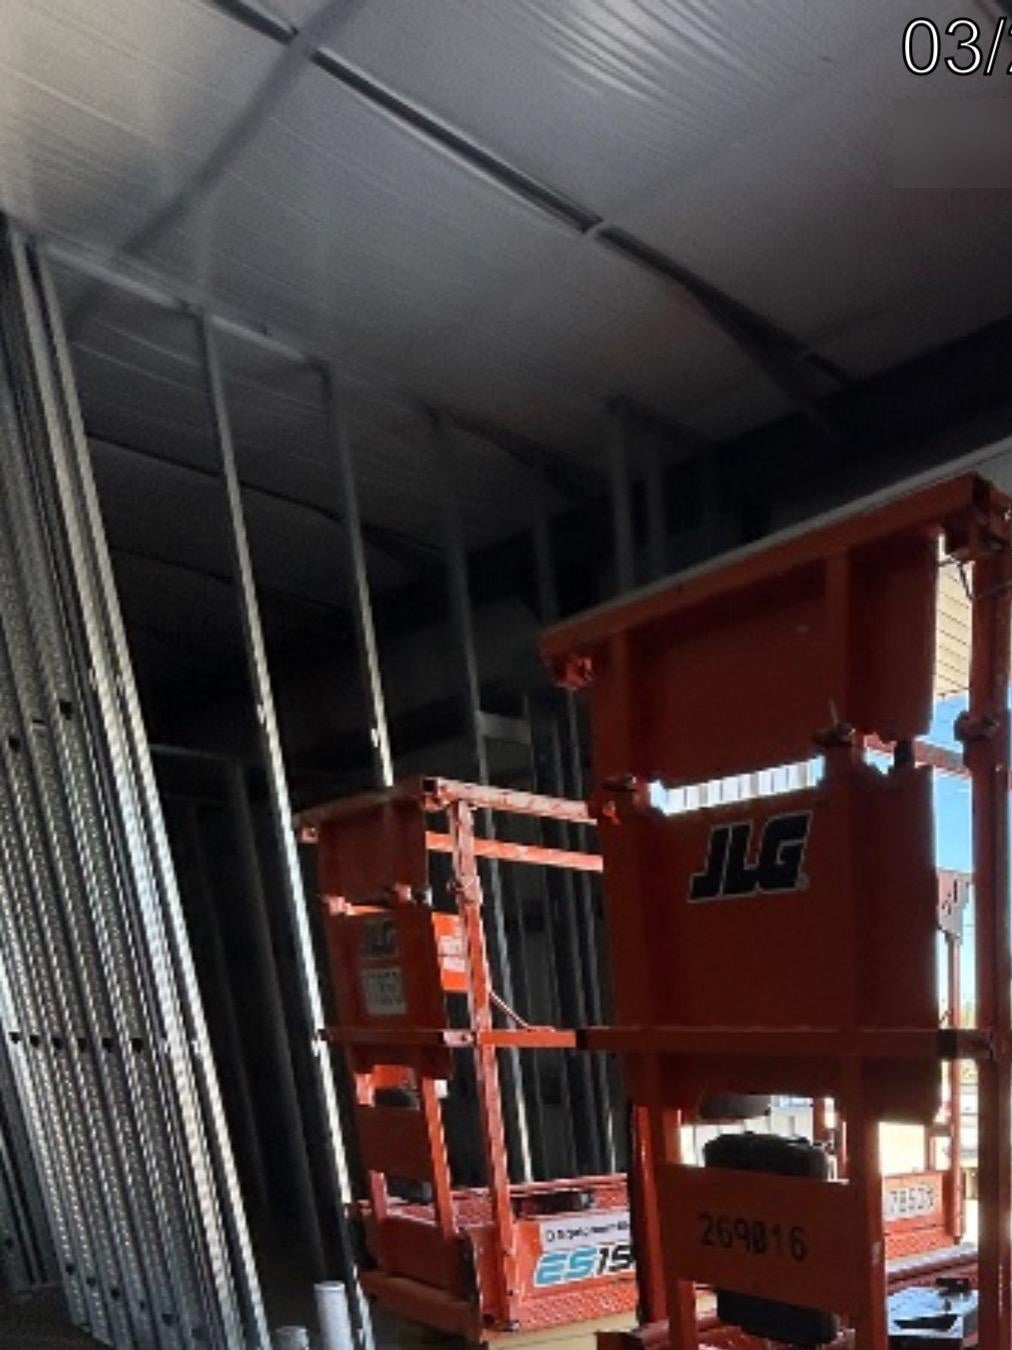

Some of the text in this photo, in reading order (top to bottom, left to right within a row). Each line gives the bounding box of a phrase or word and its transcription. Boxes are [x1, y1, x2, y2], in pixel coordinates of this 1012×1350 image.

[688, 810, 812, 903] JLG
[701, 1213, 808, 1261] 269016
[534, 1246, 635, 1287] ES19
